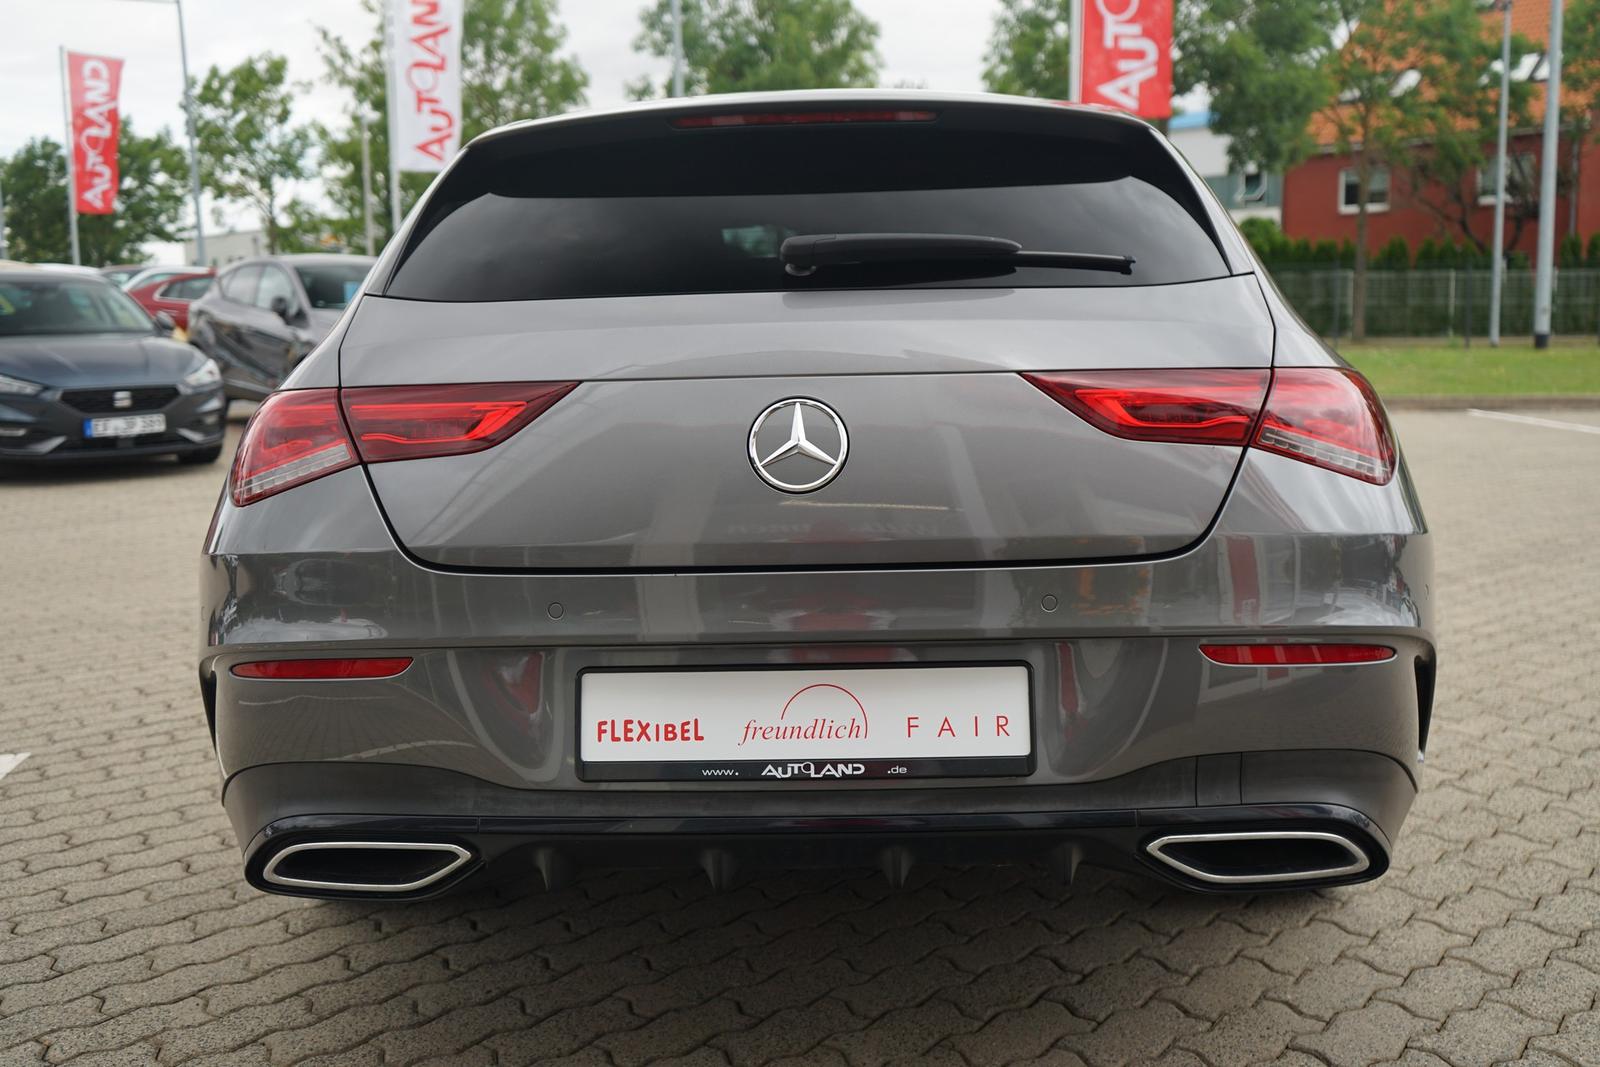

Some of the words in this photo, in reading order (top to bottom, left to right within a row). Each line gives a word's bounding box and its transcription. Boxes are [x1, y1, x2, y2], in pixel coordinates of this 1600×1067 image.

[80, 60, 116, 209] AUTOLAND
[597, 718, 705, 742] FLEXIBEL
[737, 716, 861, 746] freundlich
[906, 715, 1011, 738] FAIR
[702, 768, 740, 776] www.
[761, 761, 866, 779] AUTOLAND
[887, 765, 908, 775] .de
